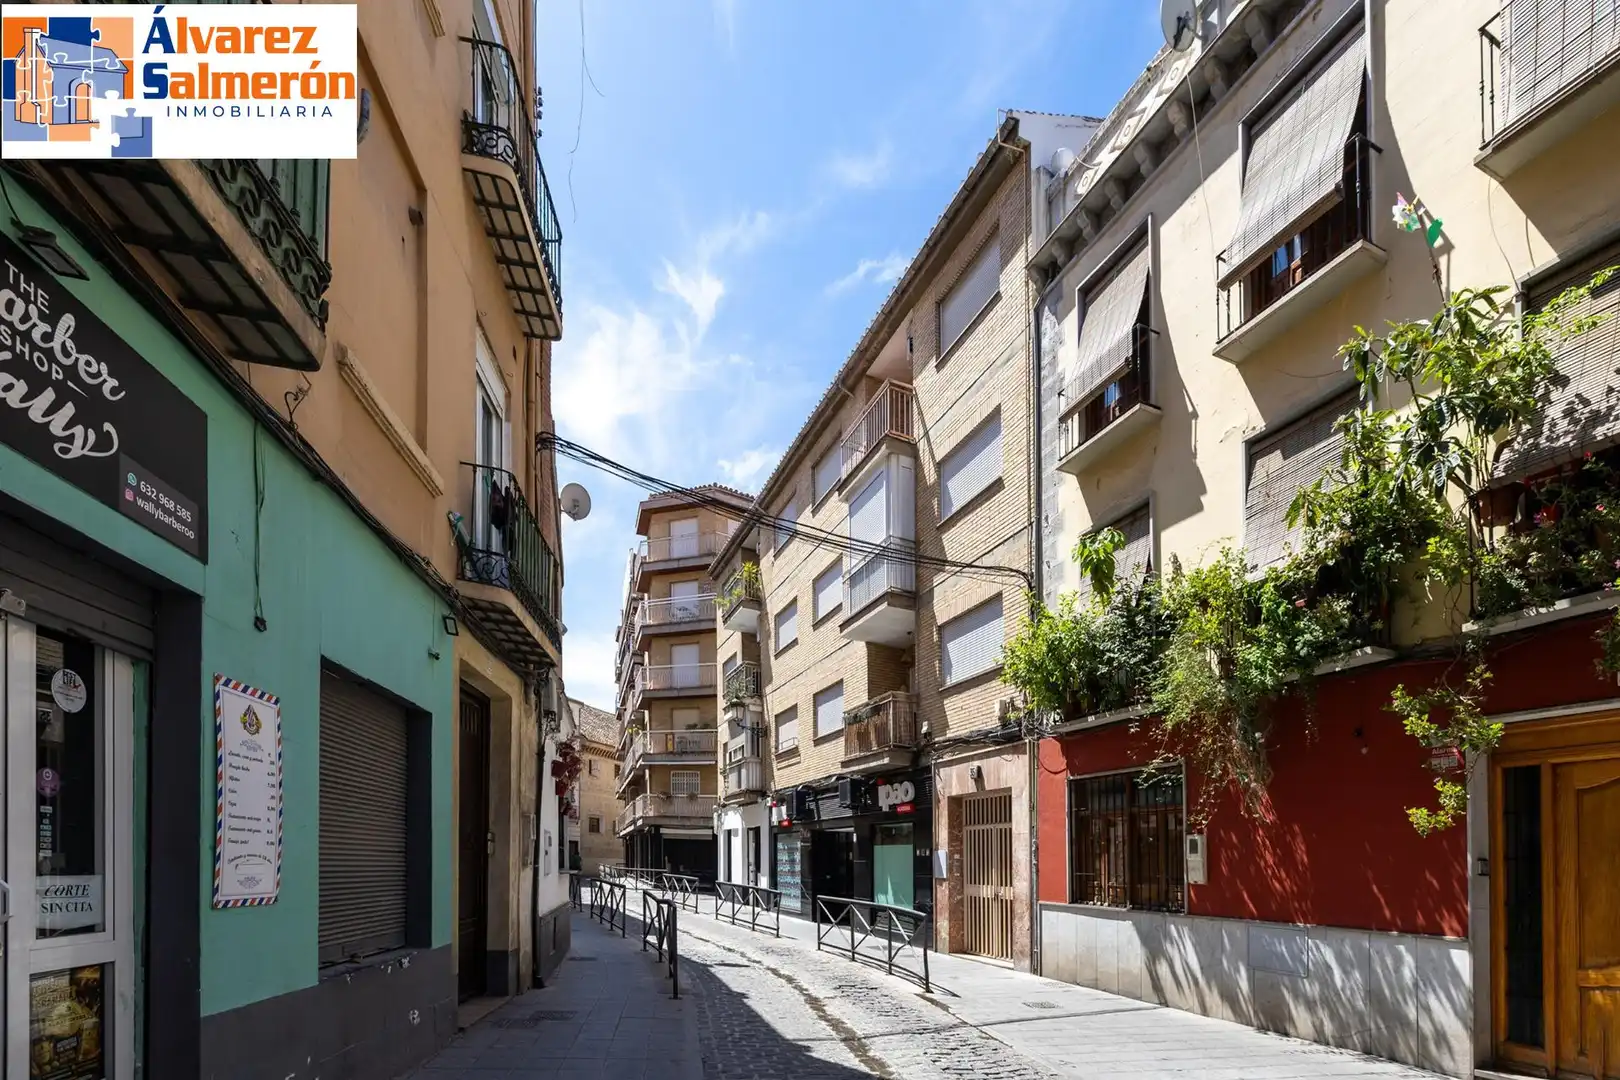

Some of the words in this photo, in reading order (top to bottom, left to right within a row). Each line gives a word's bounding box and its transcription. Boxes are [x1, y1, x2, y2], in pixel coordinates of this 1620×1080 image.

[5, 260, 49, 314] THE
[0, 288, 126, 401] arber
[0, 324, 64, 381] SHOP
[0, 351, 119, 459] ally
[136, 497, 195, 538] wallybarberoo
[140, 481, 157, 499] 632
[159, 494, 174, 511] 968
[176, 505, 191, 521] 585
[41, 902, 64, 913] SIN
[66, 901, 93, 913] CITA
[44, 884, 90, 897] CORTE
